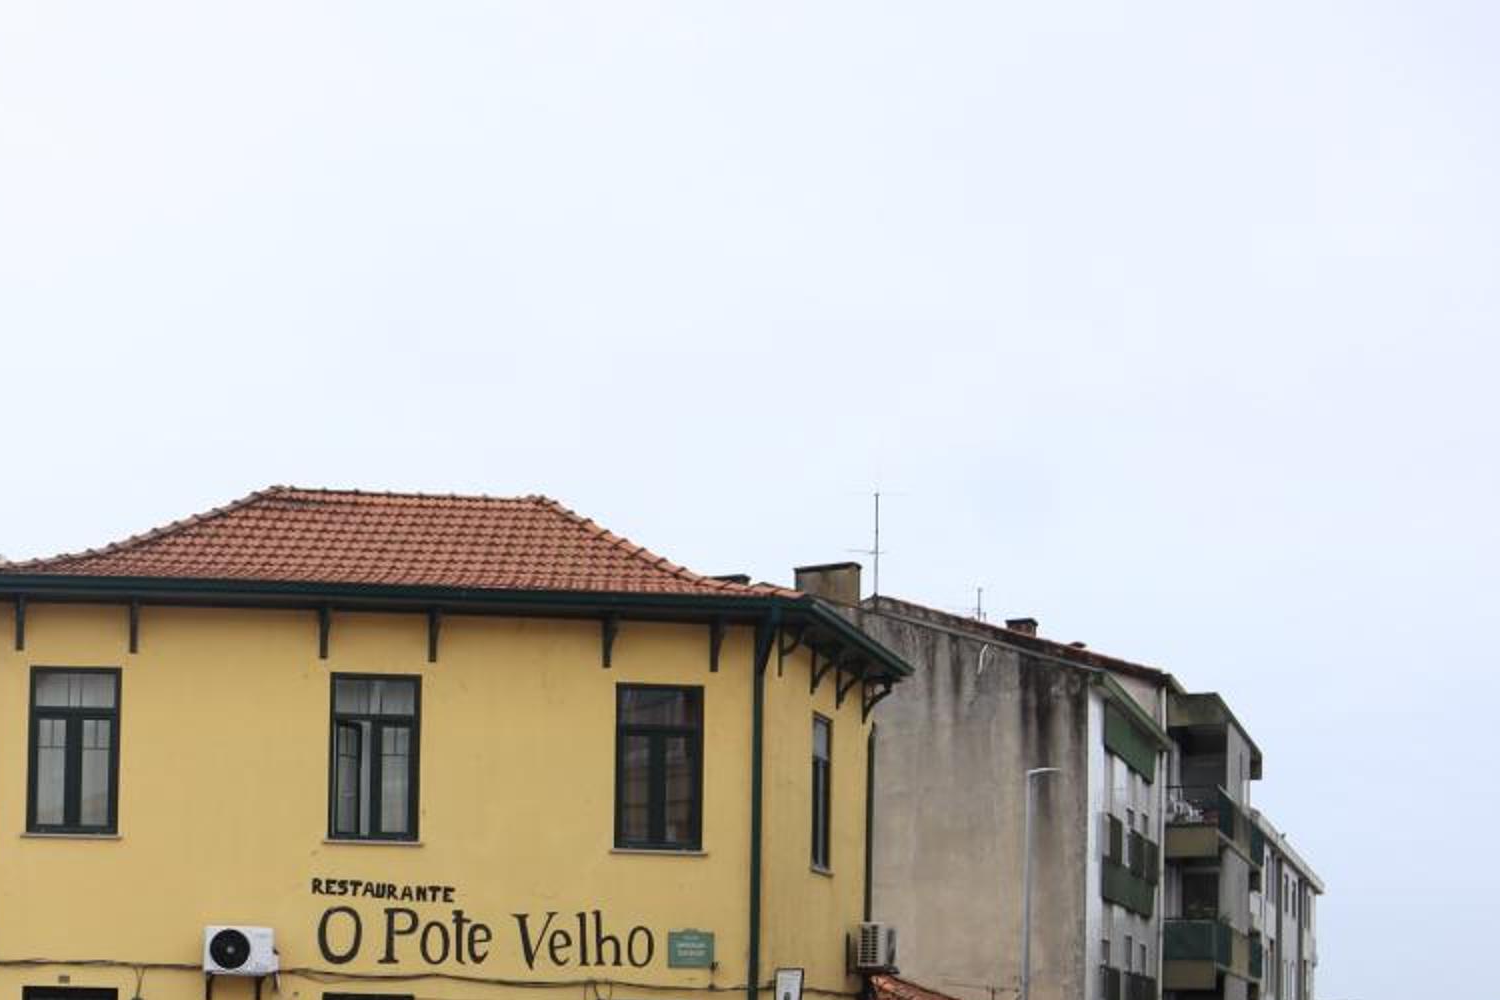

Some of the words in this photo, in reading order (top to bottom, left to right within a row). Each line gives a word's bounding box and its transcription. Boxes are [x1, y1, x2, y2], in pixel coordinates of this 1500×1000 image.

[311, 877, 455, 903] RESTAURANTE
[317, 905, 362, 965] O
[377, 907, 492, 965] Pote
[511, 909, 655, 970] Velho
